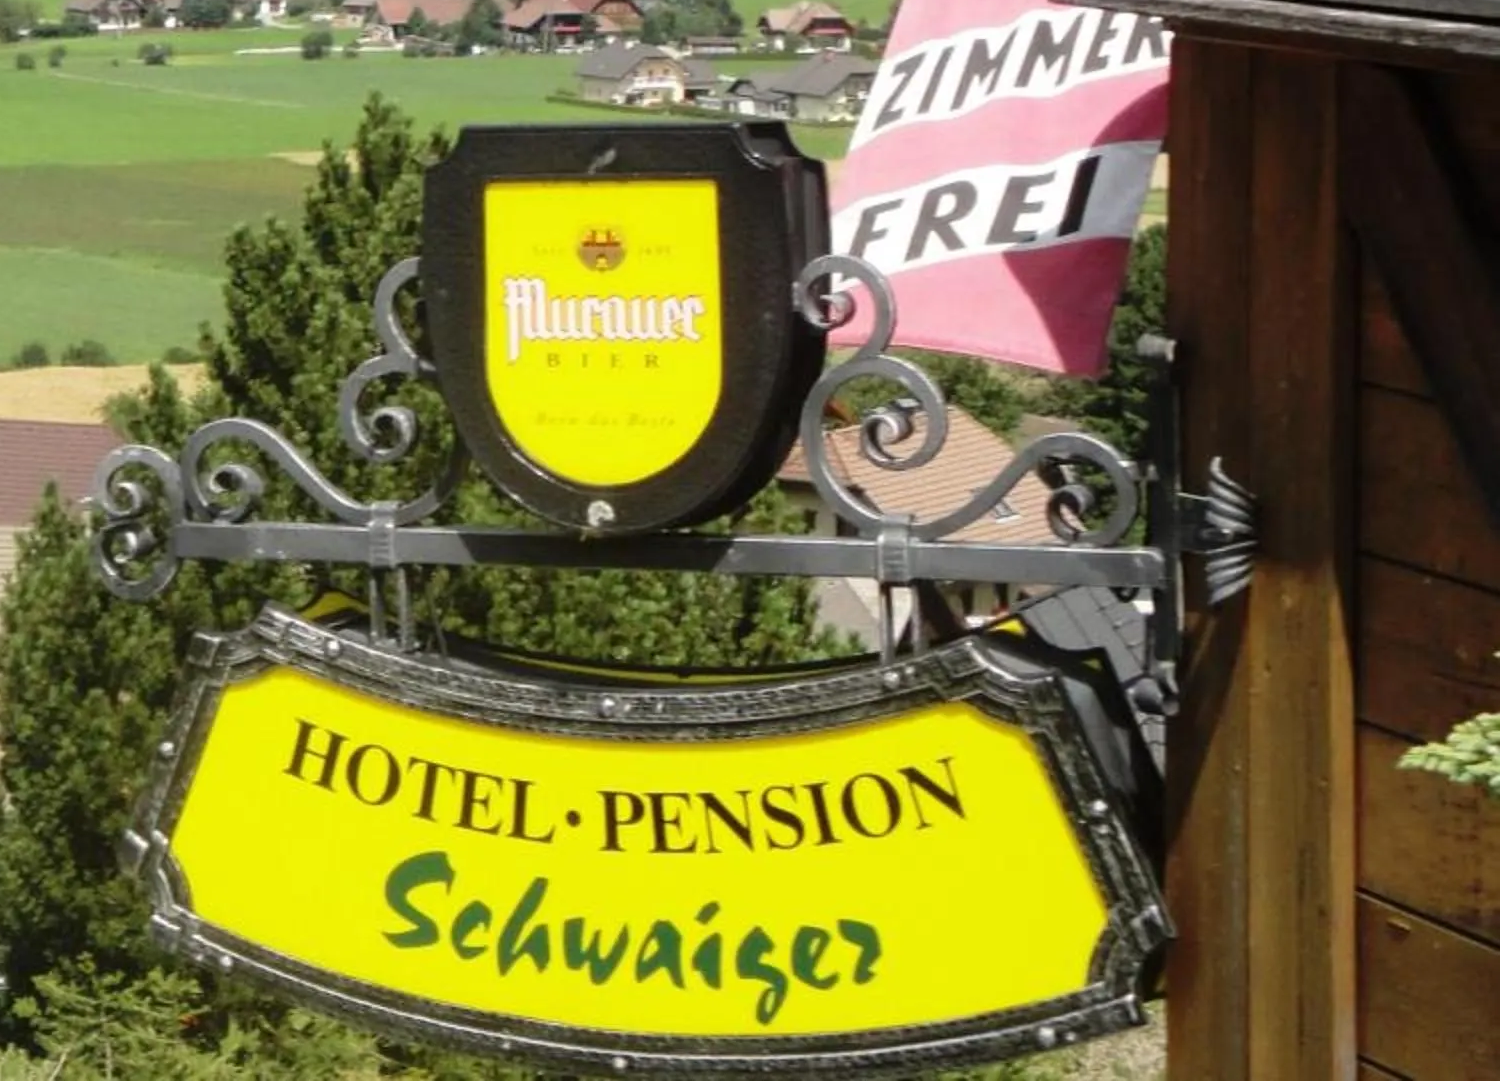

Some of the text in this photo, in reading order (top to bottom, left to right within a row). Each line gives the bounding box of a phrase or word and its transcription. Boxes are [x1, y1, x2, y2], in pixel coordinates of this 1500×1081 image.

[873, 8, 1165, 131] ZIMMER
[840, 155, 1103, 282] FREI
[502, 275, 706, 365] Murauer
[547, 352, 661, 369] BIER
[283, 717, 967, 855] HOTEL PENSION
[382, 850, 883, 1026] Schwaiger
